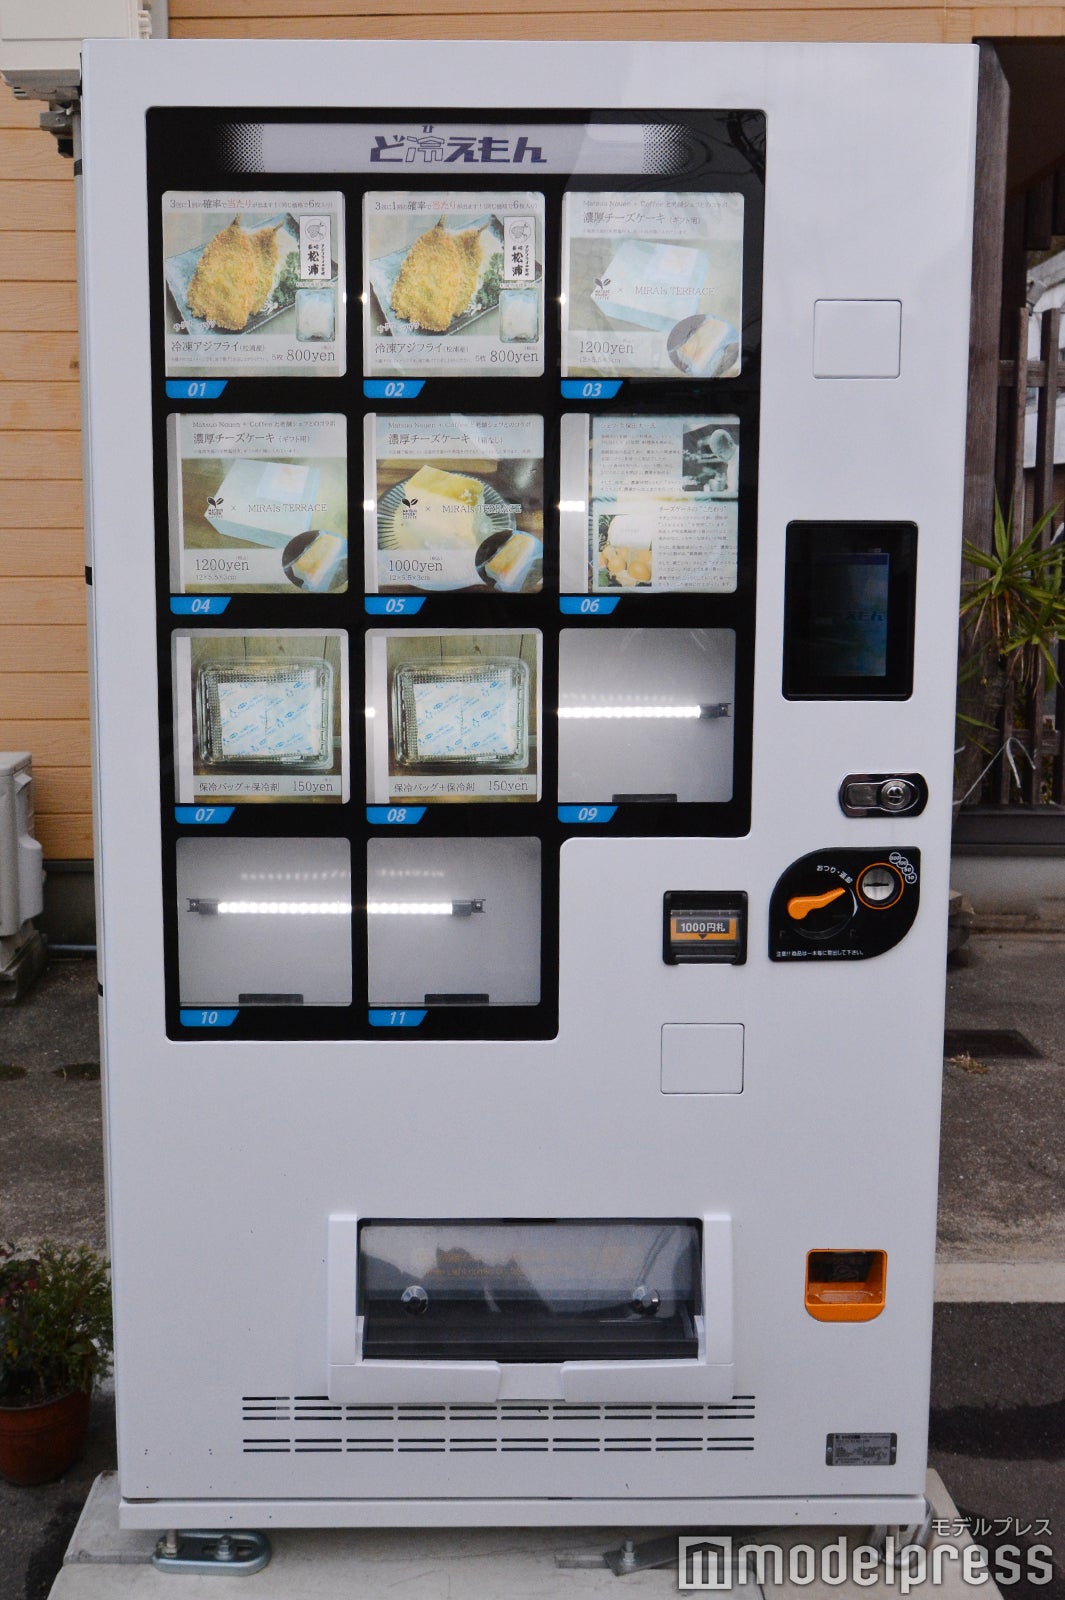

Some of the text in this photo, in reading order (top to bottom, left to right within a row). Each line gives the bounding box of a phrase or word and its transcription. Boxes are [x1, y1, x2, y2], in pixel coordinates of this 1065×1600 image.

[370, 135, 547, 163] ど冷えもん
[583, 211, 665, 224] 濃厚チーズケーキ
[579, 340, 634, 355] 1200yen
[286, 349, 335, 362] 800yen
[490, 350, 539, 363] 800yen
[187, 382, 207, 397] 01
[385, 382, 405, 397] 02
[582, 383, 602, 397] 03
[193, 432, 275, 444] 濃厚チーズケーキ
[389, 433, 470, 445] 濃厚チーズケーキ
[282, 503, 327, 513] TERRACE
[195, 558, 250, 572] 1200yen
[388, 559, 443, 573] 1000yen
[191, 598, 211, 613] 04
[385, 598, 406, 613] 05
[580, 598, 600, 613] 06
[293, 780, 334, 793] 150yen
[488, 780, 529, 793] 150yen
[195, 808, 215, 822] 07
[387, 808, 407, 822] 08
[578, 807, 598, 821] 09
[680, 922, 726, 932] 1000円札
[201, 1011, 218, 1025] 10
[389, 1011, 406, 1025] 11
